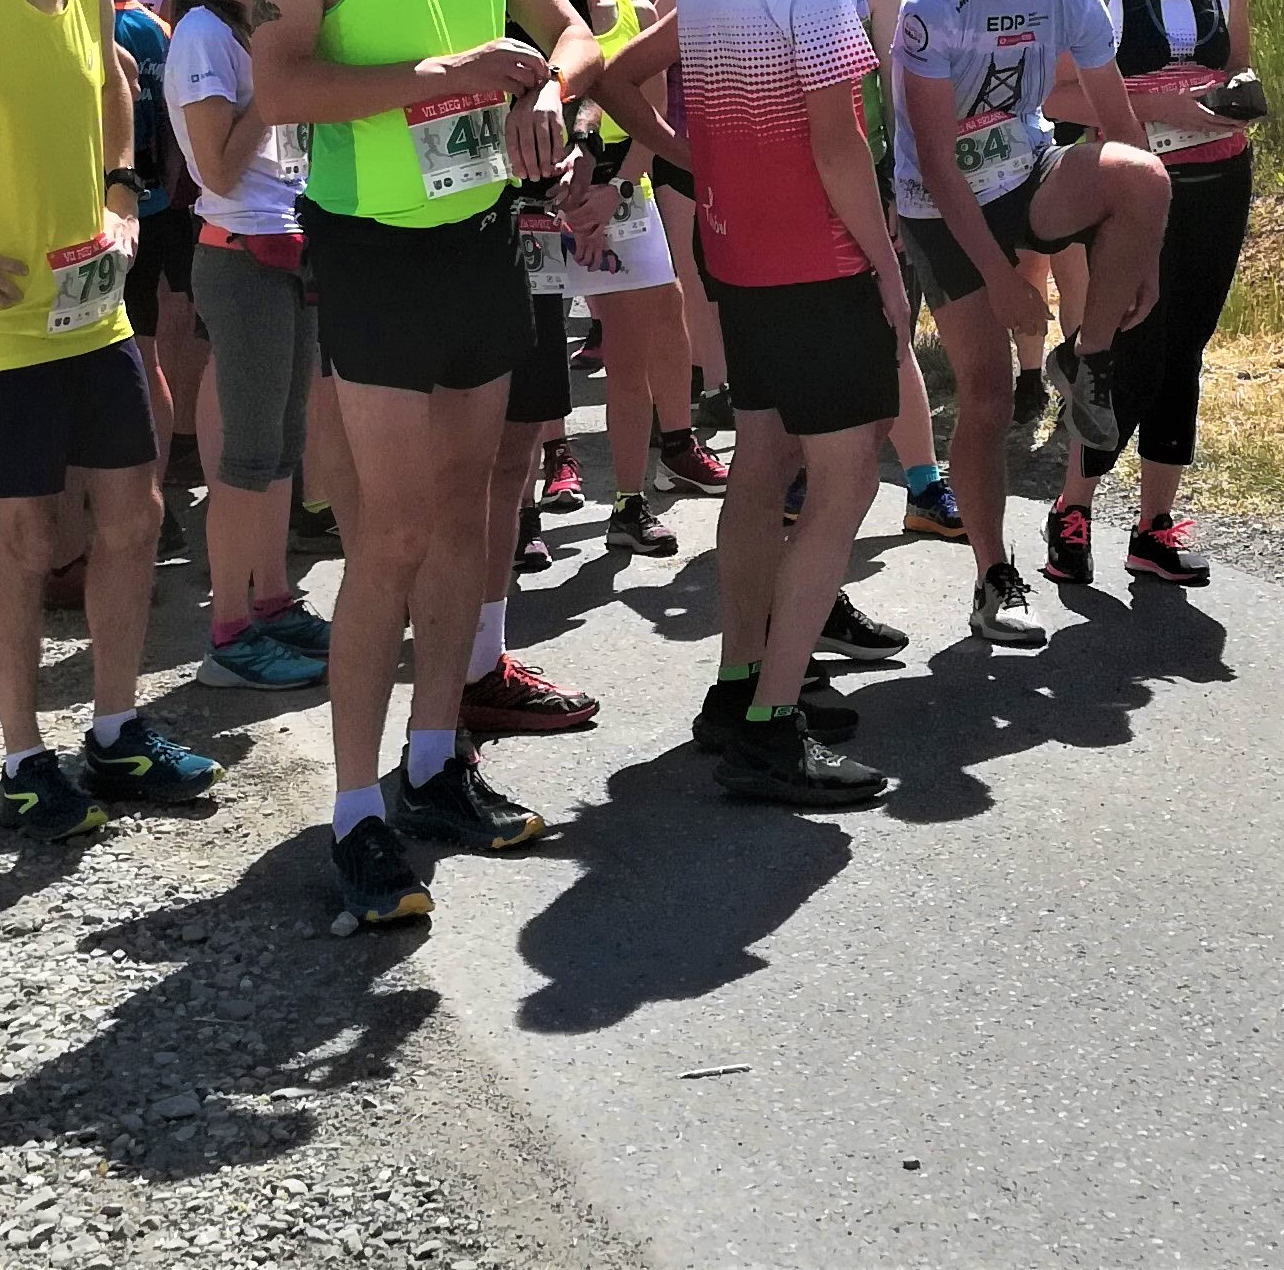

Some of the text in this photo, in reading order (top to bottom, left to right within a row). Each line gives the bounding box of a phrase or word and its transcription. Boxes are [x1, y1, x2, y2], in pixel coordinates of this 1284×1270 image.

[986, 13, 1026, 32] EDP
[437, 99, 462, 115] BIEG
[446, 109, 500, 160] 44
[955, 125, 1011, 173] 84
[77, 253, 116, 305] 79
